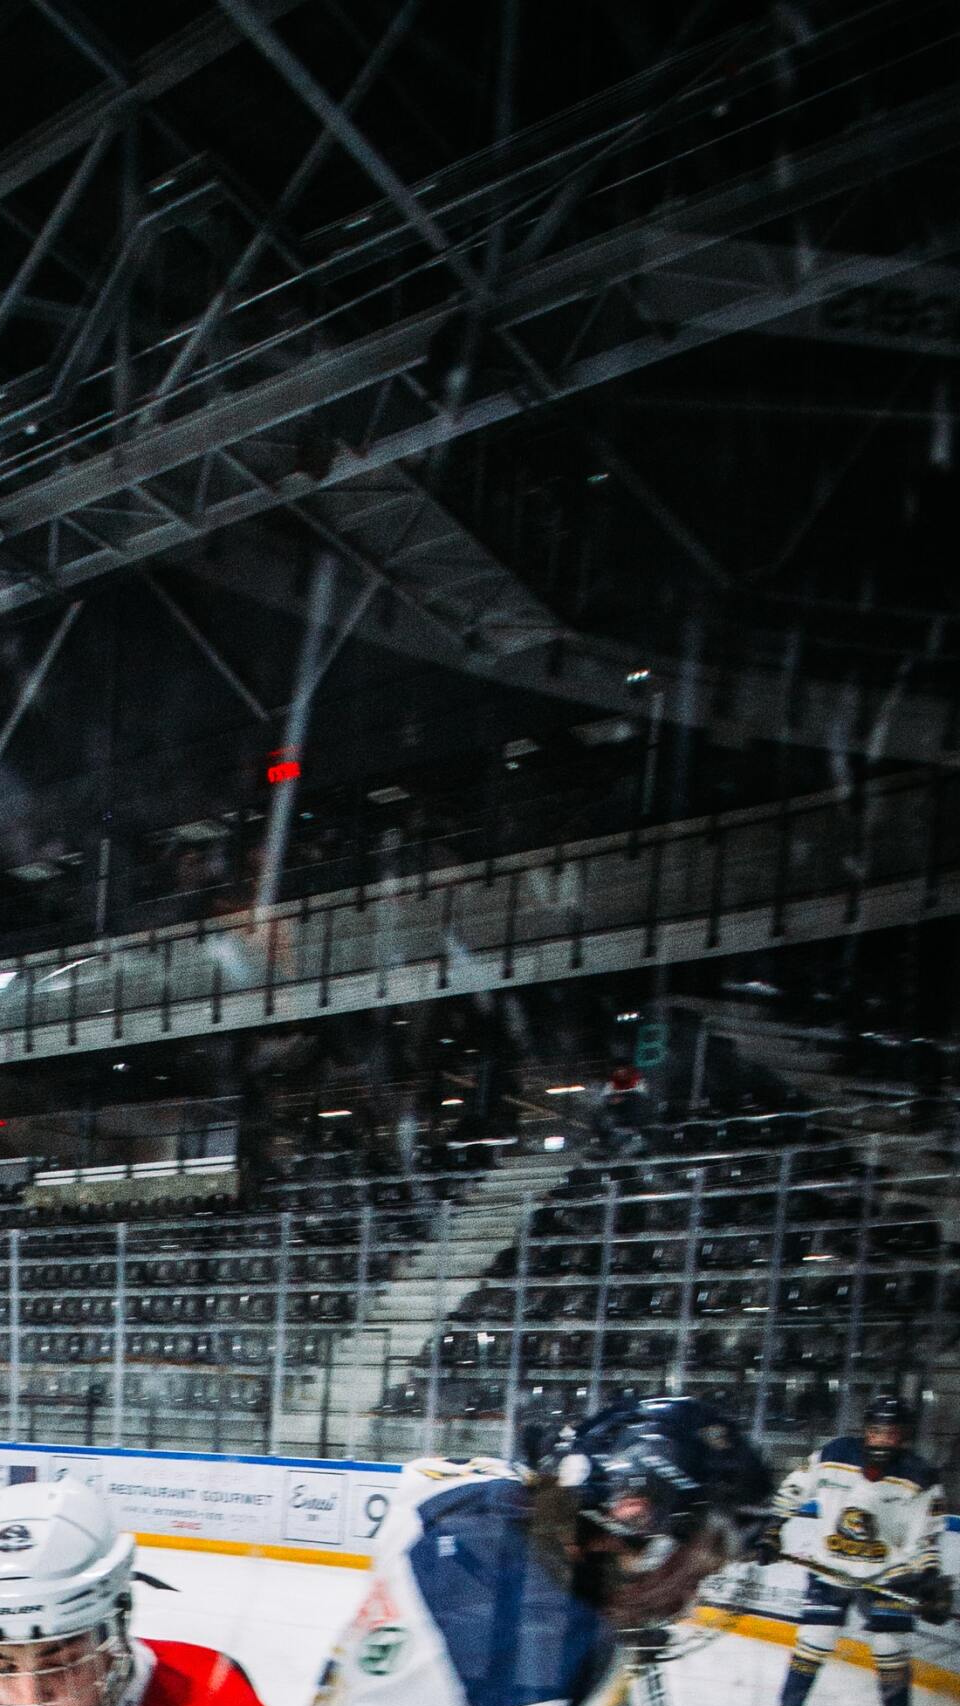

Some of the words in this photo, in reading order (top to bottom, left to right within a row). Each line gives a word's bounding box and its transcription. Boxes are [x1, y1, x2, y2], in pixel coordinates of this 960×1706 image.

[108, 1482, 196, 1500] RESTAURANT
[201, 1489, 275, 1506] GOURMET
[366, 1493, 389, 1539] 9
